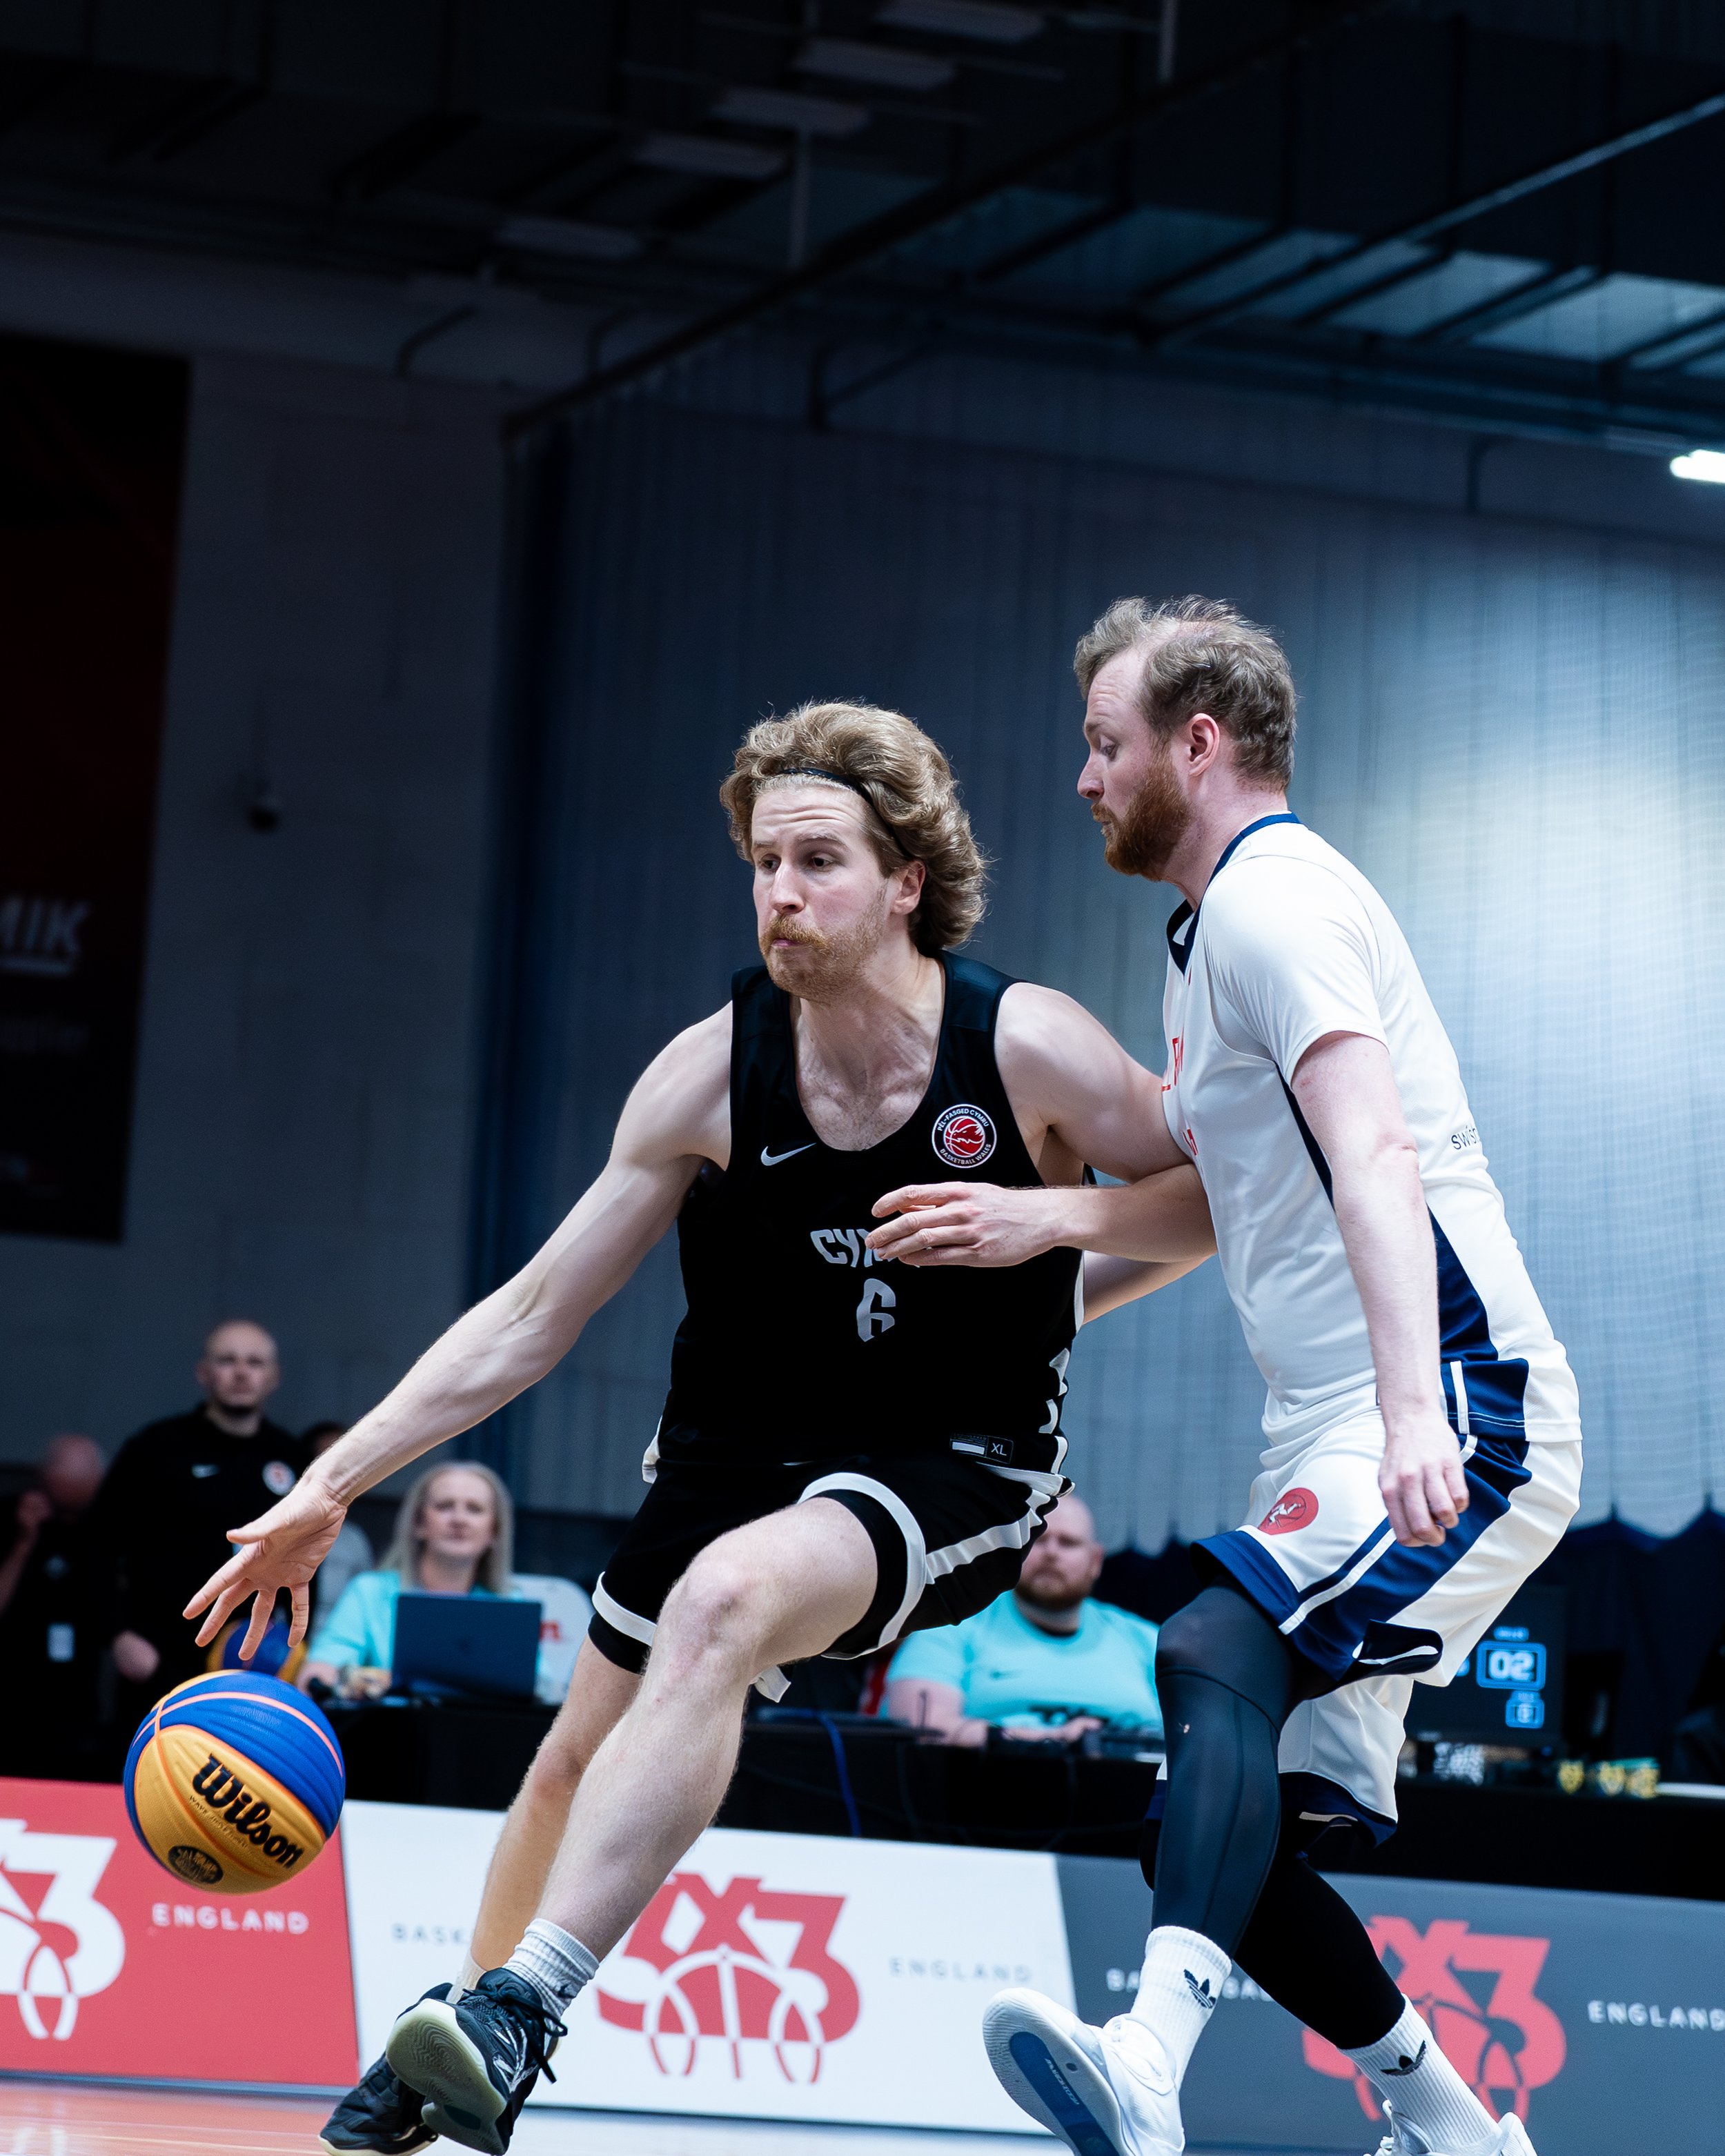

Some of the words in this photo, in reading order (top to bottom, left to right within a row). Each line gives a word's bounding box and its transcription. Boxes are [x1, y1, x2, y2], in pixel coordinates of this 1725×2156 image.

[969, 1109, 989, 1127] CYMRU
[940, 1148, 976, 1165] BASKETBALL
[975, 1143, 992, 1161] WALES
[856, 1278, 896, 1343] 6
[991, 1443, 1007, 1456] XL
[1488, 1650, 1535, 1683] 02
[193, 1752, 304, 1869] Wilson
[151, 1902, 310, 1935] ENGLAND
[888, 1955, 1034, 1984] ENGLAND
[1588, 2000, 1725, 2032] ENGLAND
